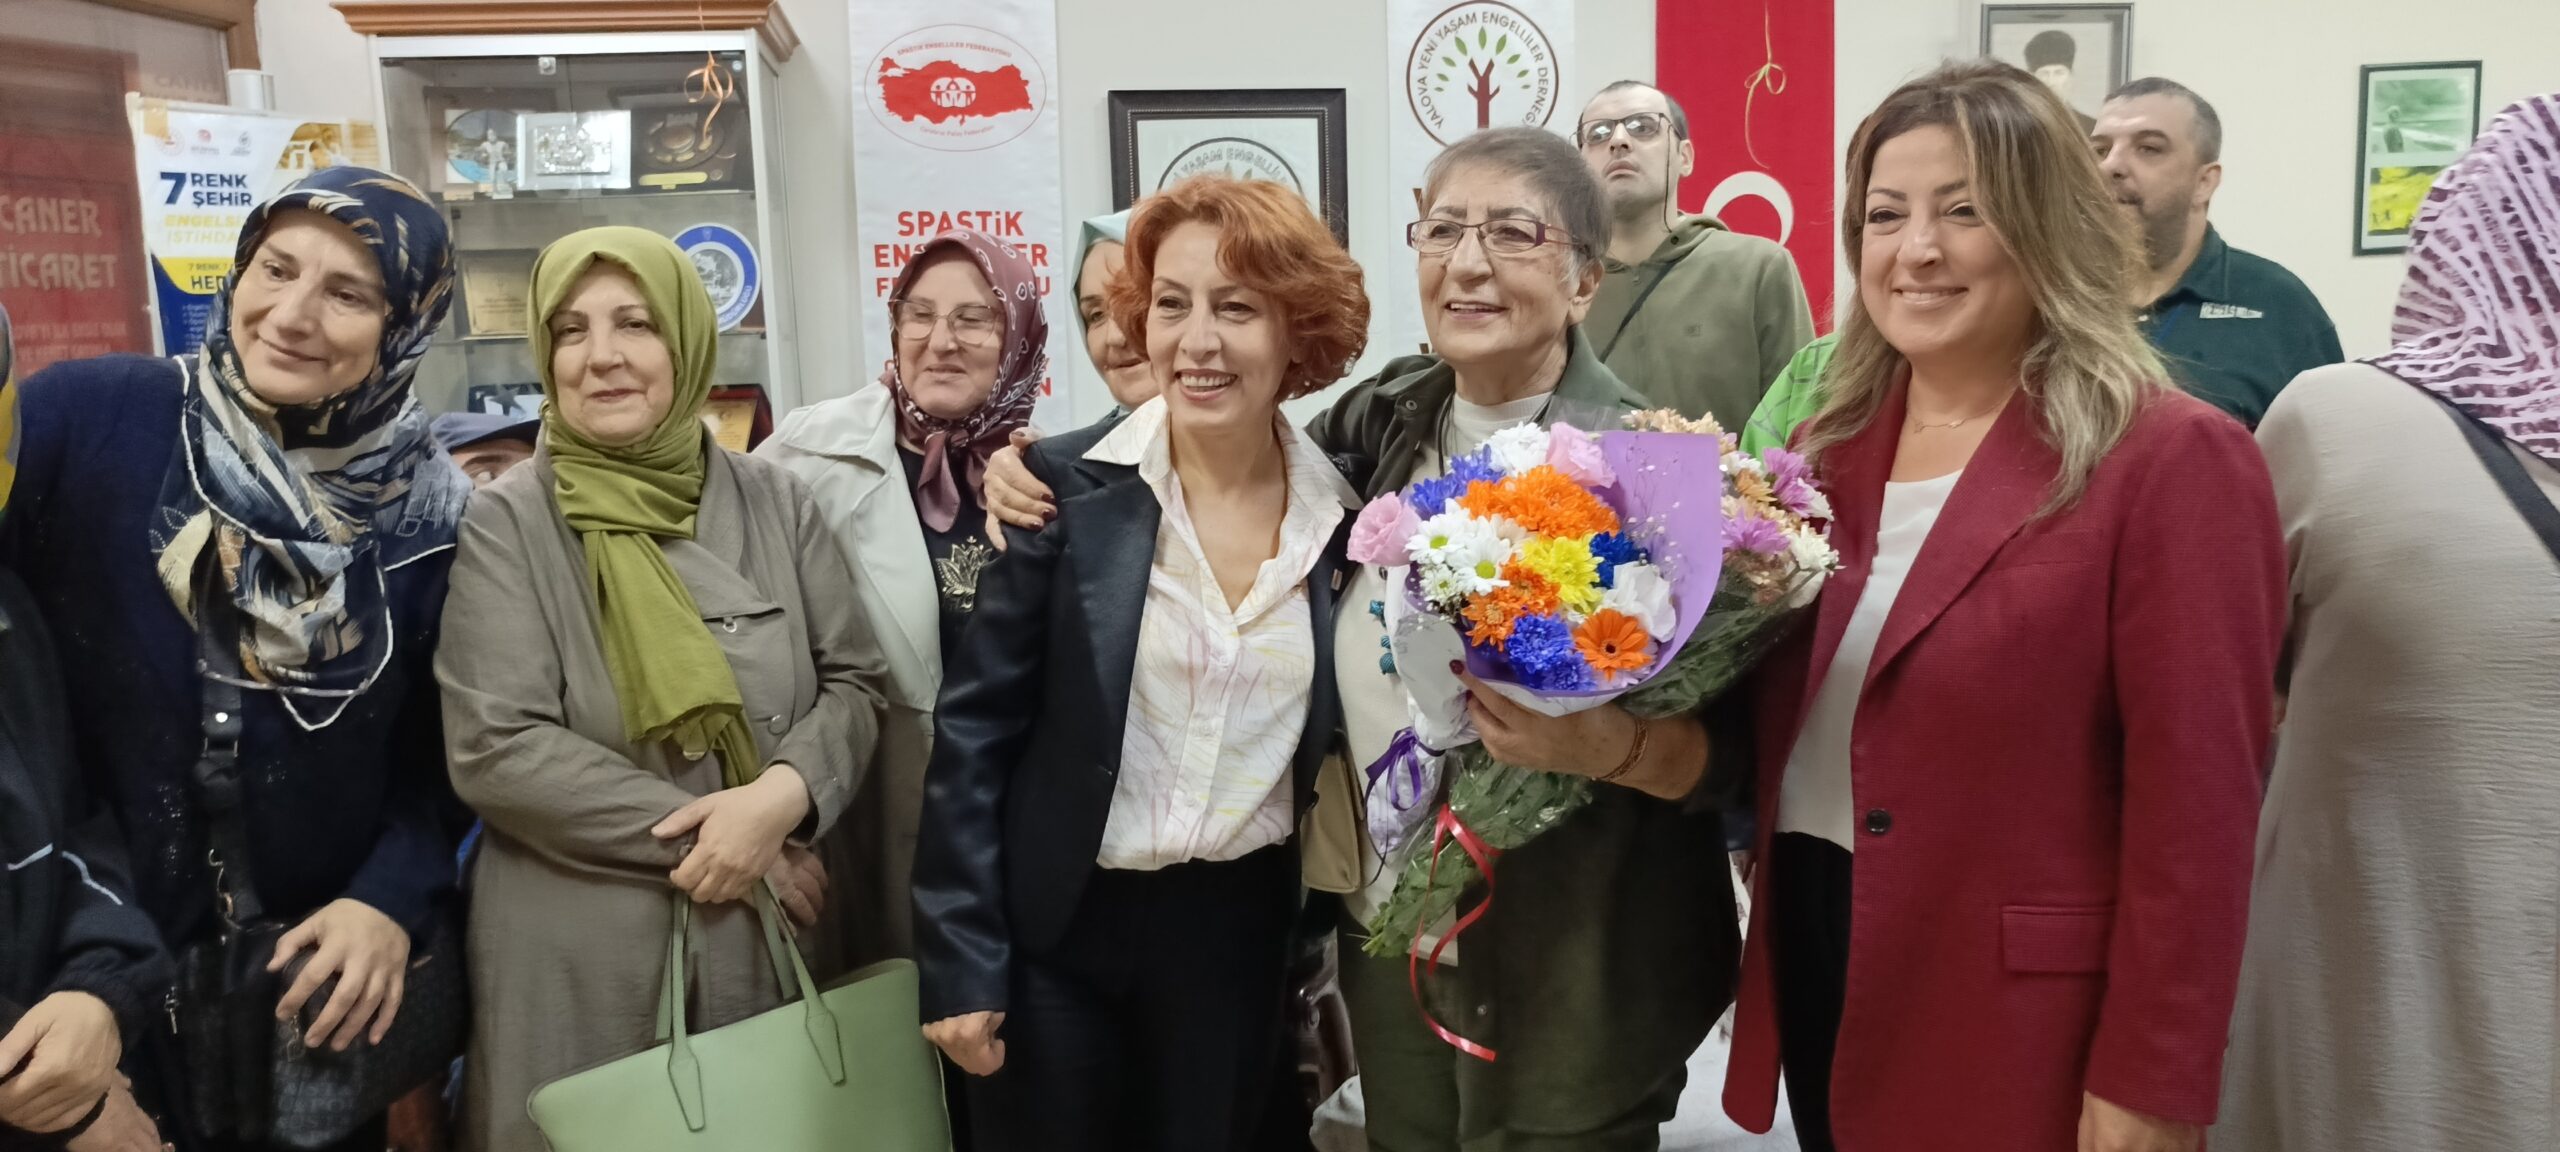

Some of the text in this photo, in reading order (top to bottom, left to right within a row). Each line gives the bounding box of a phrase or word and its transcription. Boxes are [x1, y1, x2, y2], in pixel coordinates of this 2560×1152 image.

[1435, 12, 1478, 41] YAŞAM
[1482, 11, 1544, 62] ENGELLİLER
[1418, 37, 1438, 70] YENİ
[1418, 76, 1444, 129] YALOVA
[160, 171, 187, 205] 7
[190, 172, 248, 189] RENK
